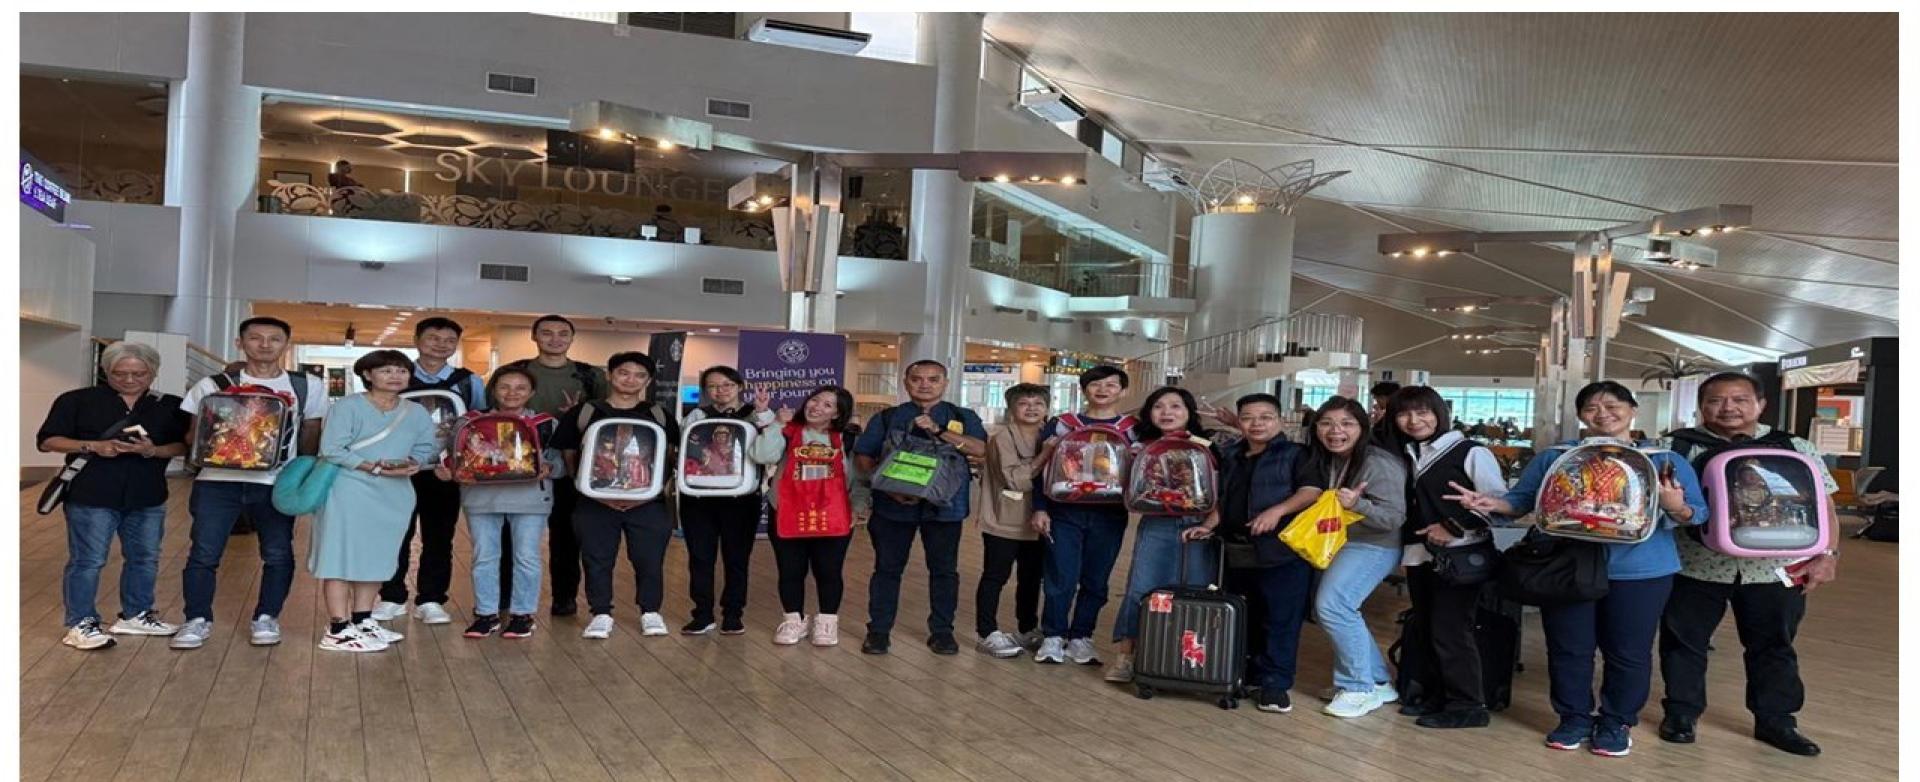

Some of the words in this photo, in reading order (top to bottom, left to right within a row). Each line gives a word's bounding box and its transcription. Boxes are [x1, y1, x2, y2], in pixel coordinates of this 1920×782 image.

[435, 153, 525, 186] SKY
[541, 161, 724, 201] LOUNGE
[744, 368, 806, 380] Bringing
[809, 367, 835, 378] you
[818, 377, 837, 385] on
